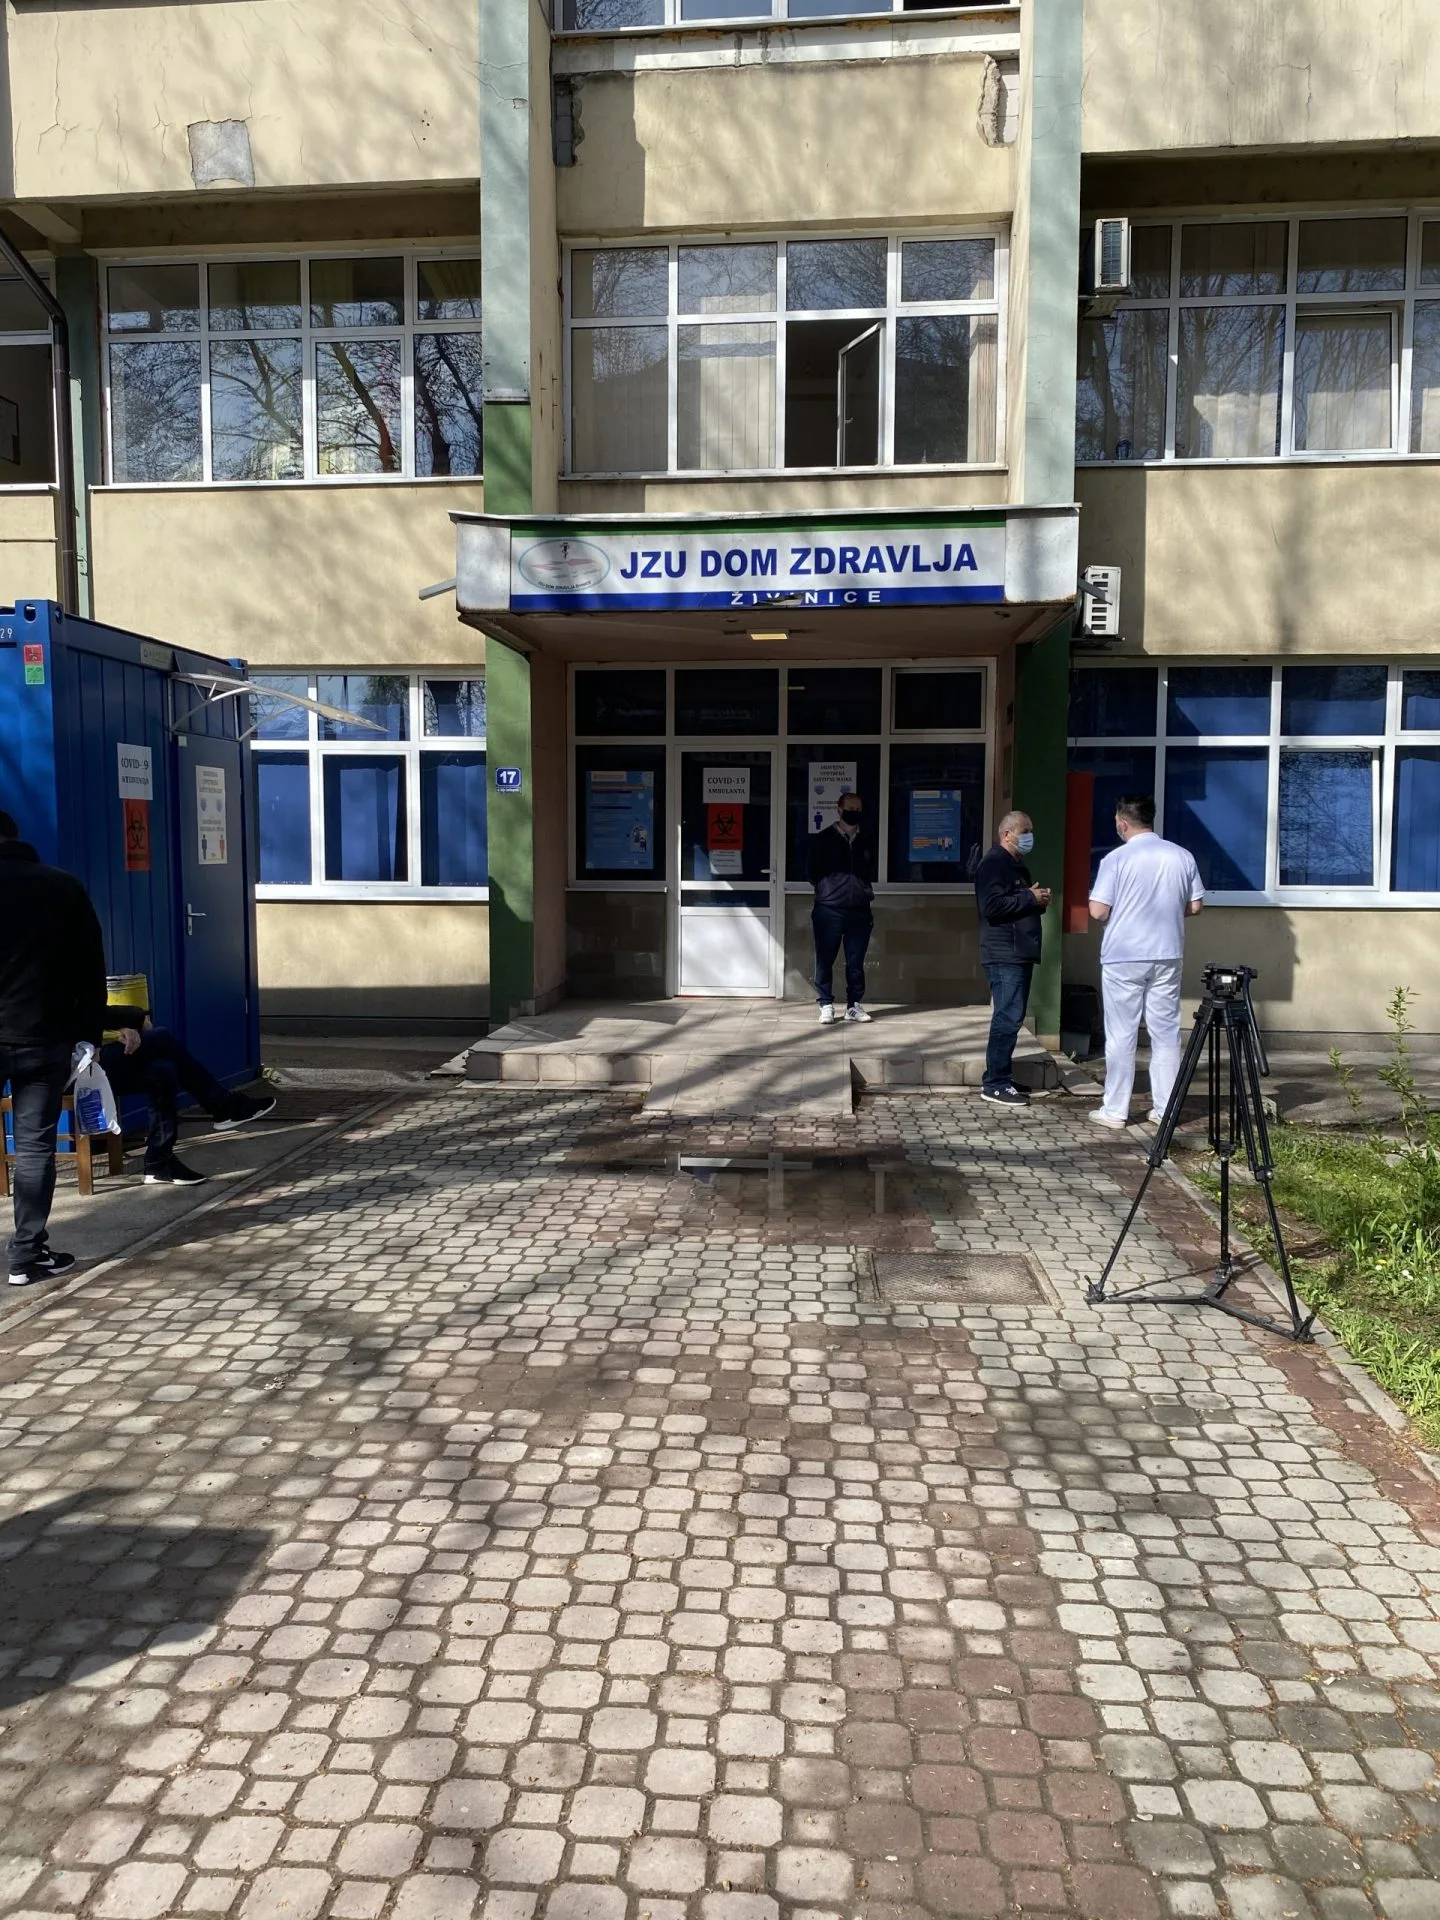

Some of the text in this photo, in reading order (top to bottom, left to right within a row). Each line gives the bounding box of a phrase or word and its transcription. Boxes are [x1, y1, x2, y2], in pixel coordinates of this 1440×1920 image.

[620, 543, 978, 579] JZU DOM ZDRAVLJA
[500, 770, 517, 784] 17
[707, 777, 746, 785] COVID-19
